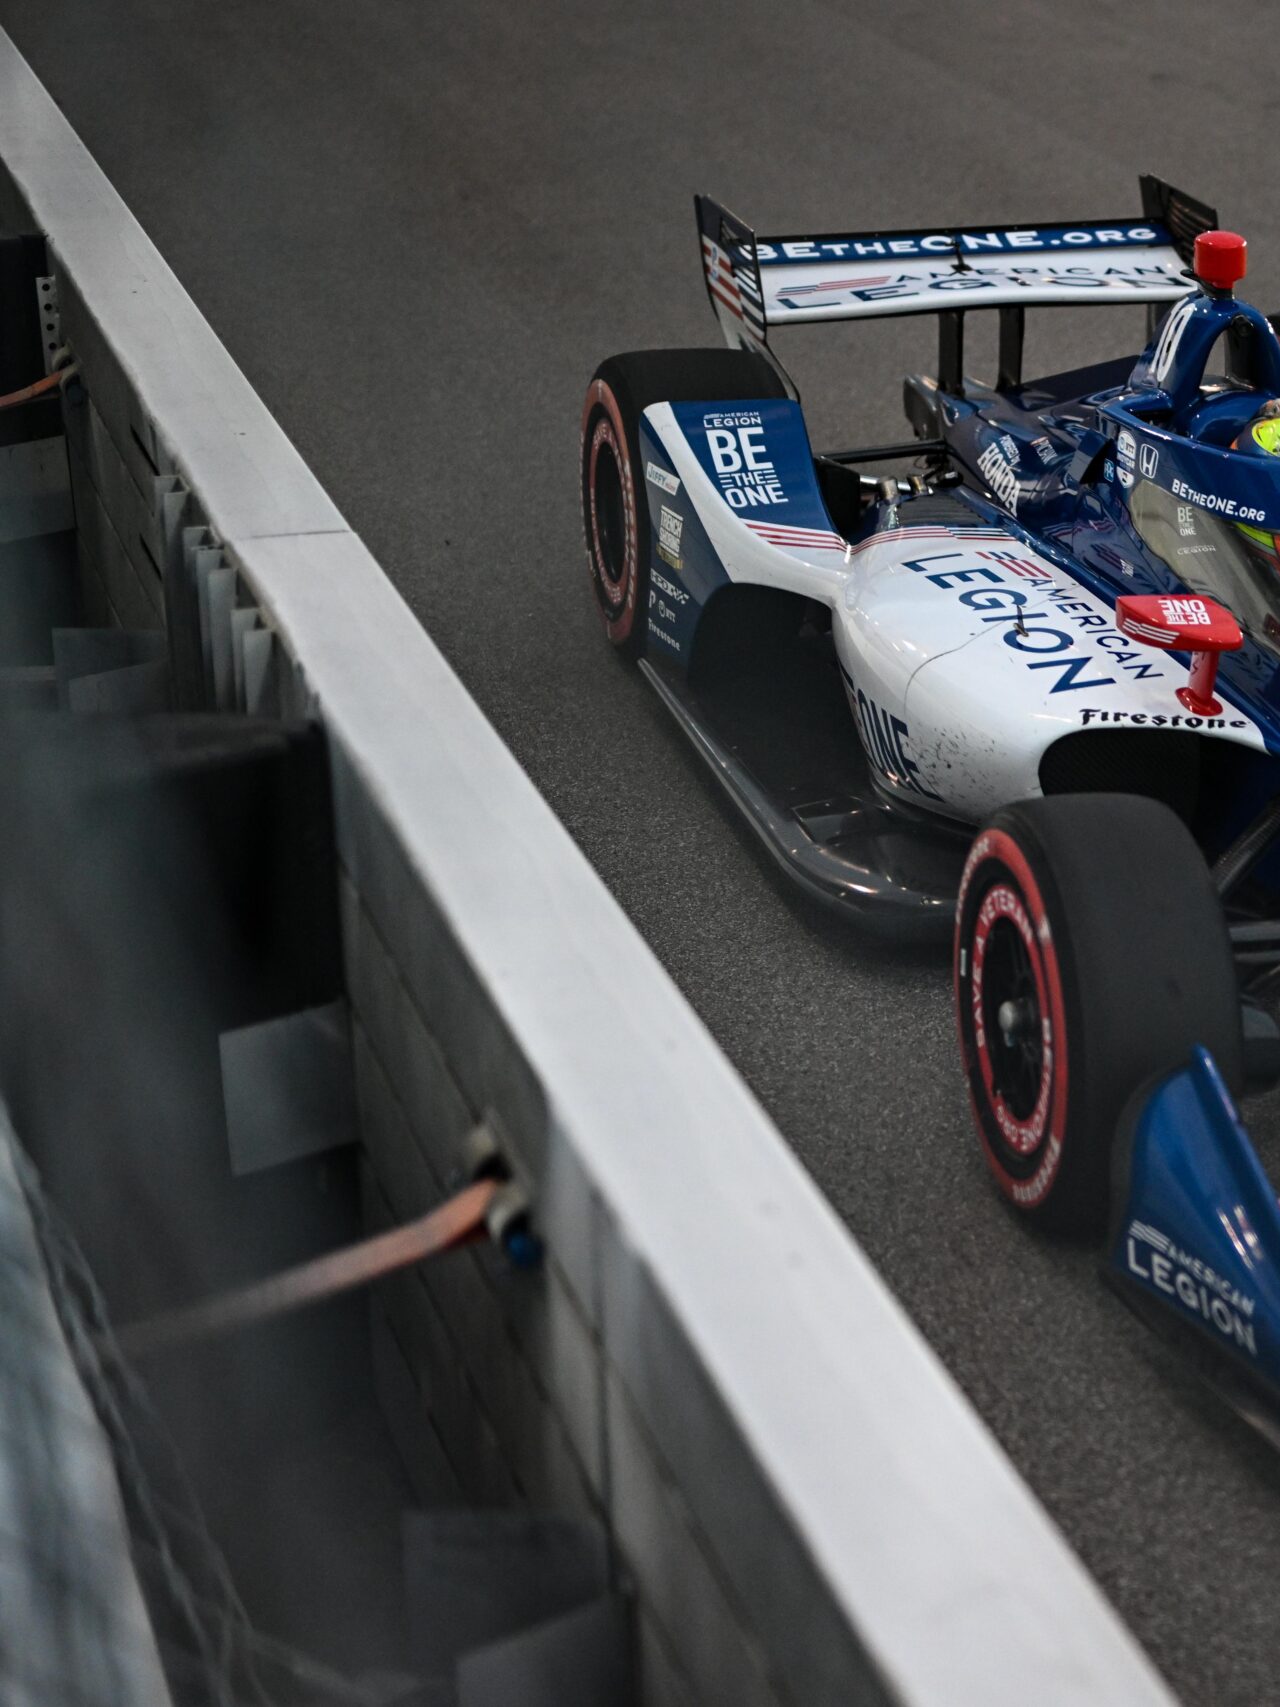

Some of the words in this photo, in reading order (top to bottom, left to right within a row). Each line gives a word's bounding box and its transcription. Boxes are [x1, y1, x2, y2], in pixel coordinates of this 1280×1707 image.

[703, 416, 762, 428] LEGION
[706, 427, 774, 474] BE
[724, 484, 789, 508] ONE
[732, 472, 766, 486] THE
[976, 442, 1021, 517] HONDA
[1171, 478, 1266, 522] BETHEONE.ORG
[1177, 506, 1194, 523] BE
[1157, 599, 1206, 613] ONE
[1186, 612, 1212, 625] BE
[901, 552, 1117, 695] LEGION
[1022, 577, 1164, 680] AMERICAN
[1079, 707, 1250, 730] Firestone
[1167, 1238, 1255, 1318] AMERICAN
[1126, 1239, 1258, 1357] LEGION
